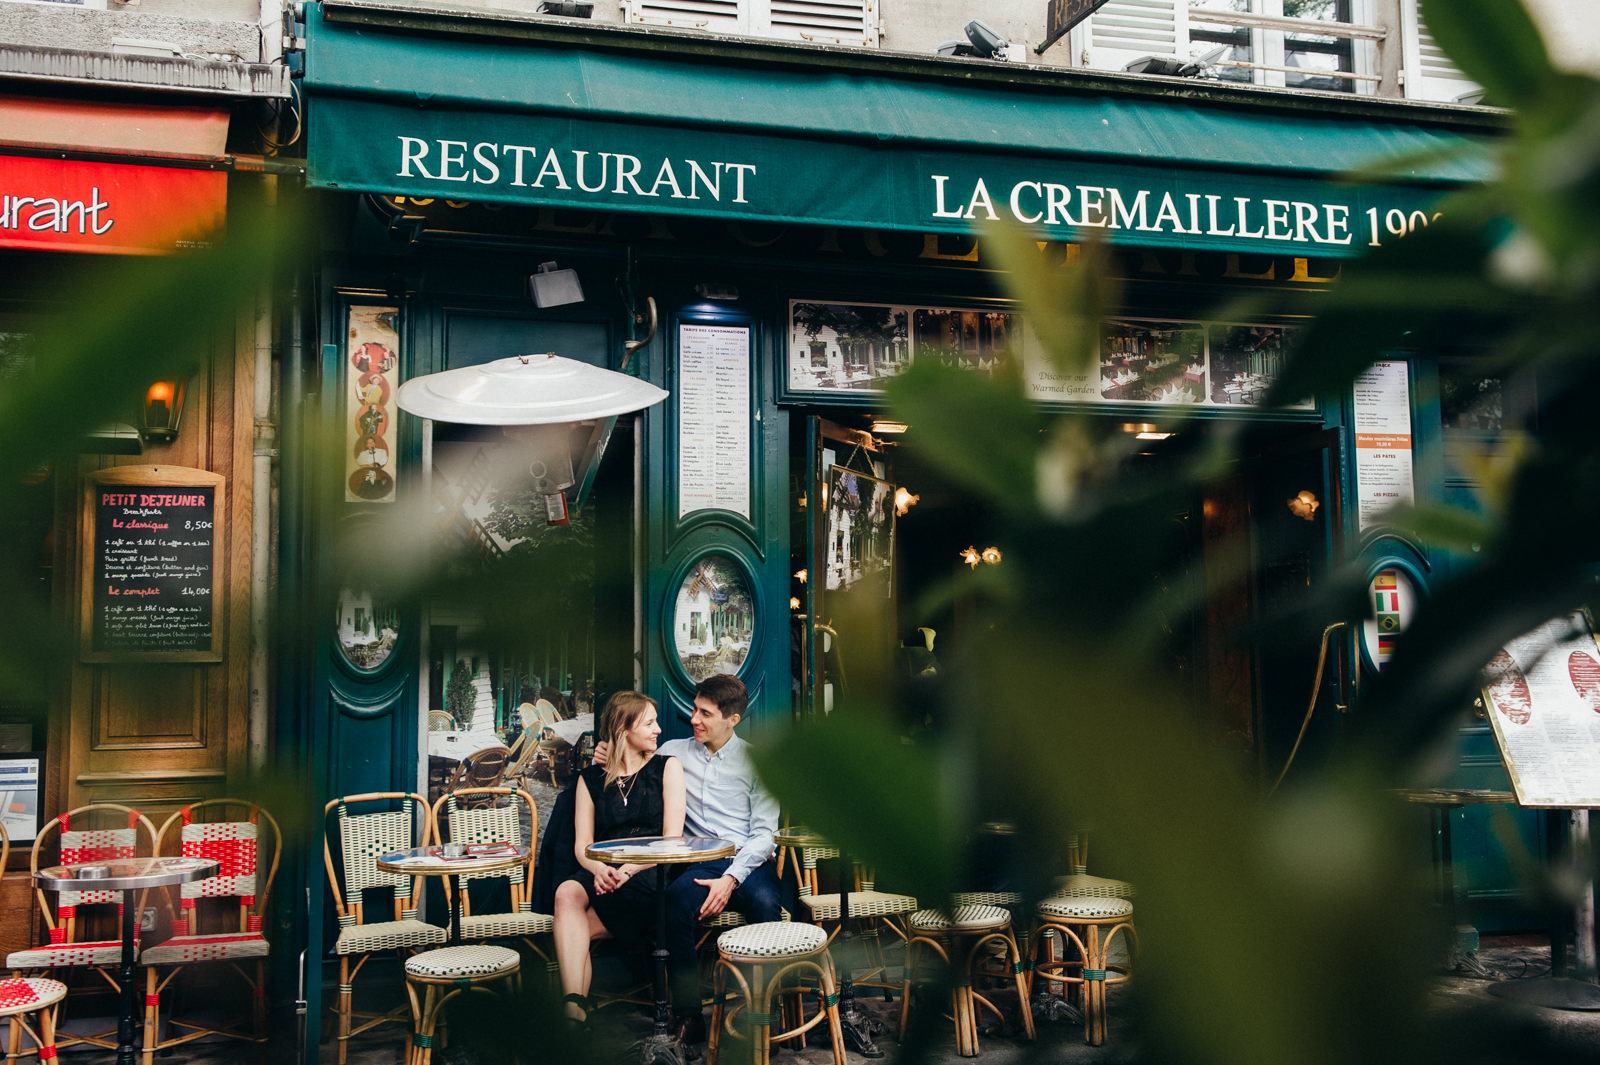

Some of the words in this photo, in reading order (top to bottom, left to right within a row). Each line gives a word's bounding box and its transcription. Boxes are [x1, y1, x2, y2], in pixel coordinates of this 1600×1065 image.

[396, 135, 757, 203] RESTAURANT
[931, 174, 1000, 221] LA
[1010, 180, 1353, 245] CREMAILLERE
[1366, 207, 1443, 247] 190
[1039, 371, 1072, 381] Discover
[1032, 383, 1064, 393] Warmed
[1066, 384, 1095, 396] Garden
[140, 494, 206, 507] DEJEUNER
[113, 518, 124, 529] Le
[125, 519, 169, 533] classique
[184, 520, 213, 531] 8,50€
[108, 585, 120, 595] Le
[122, 587, 160, 598] complet
